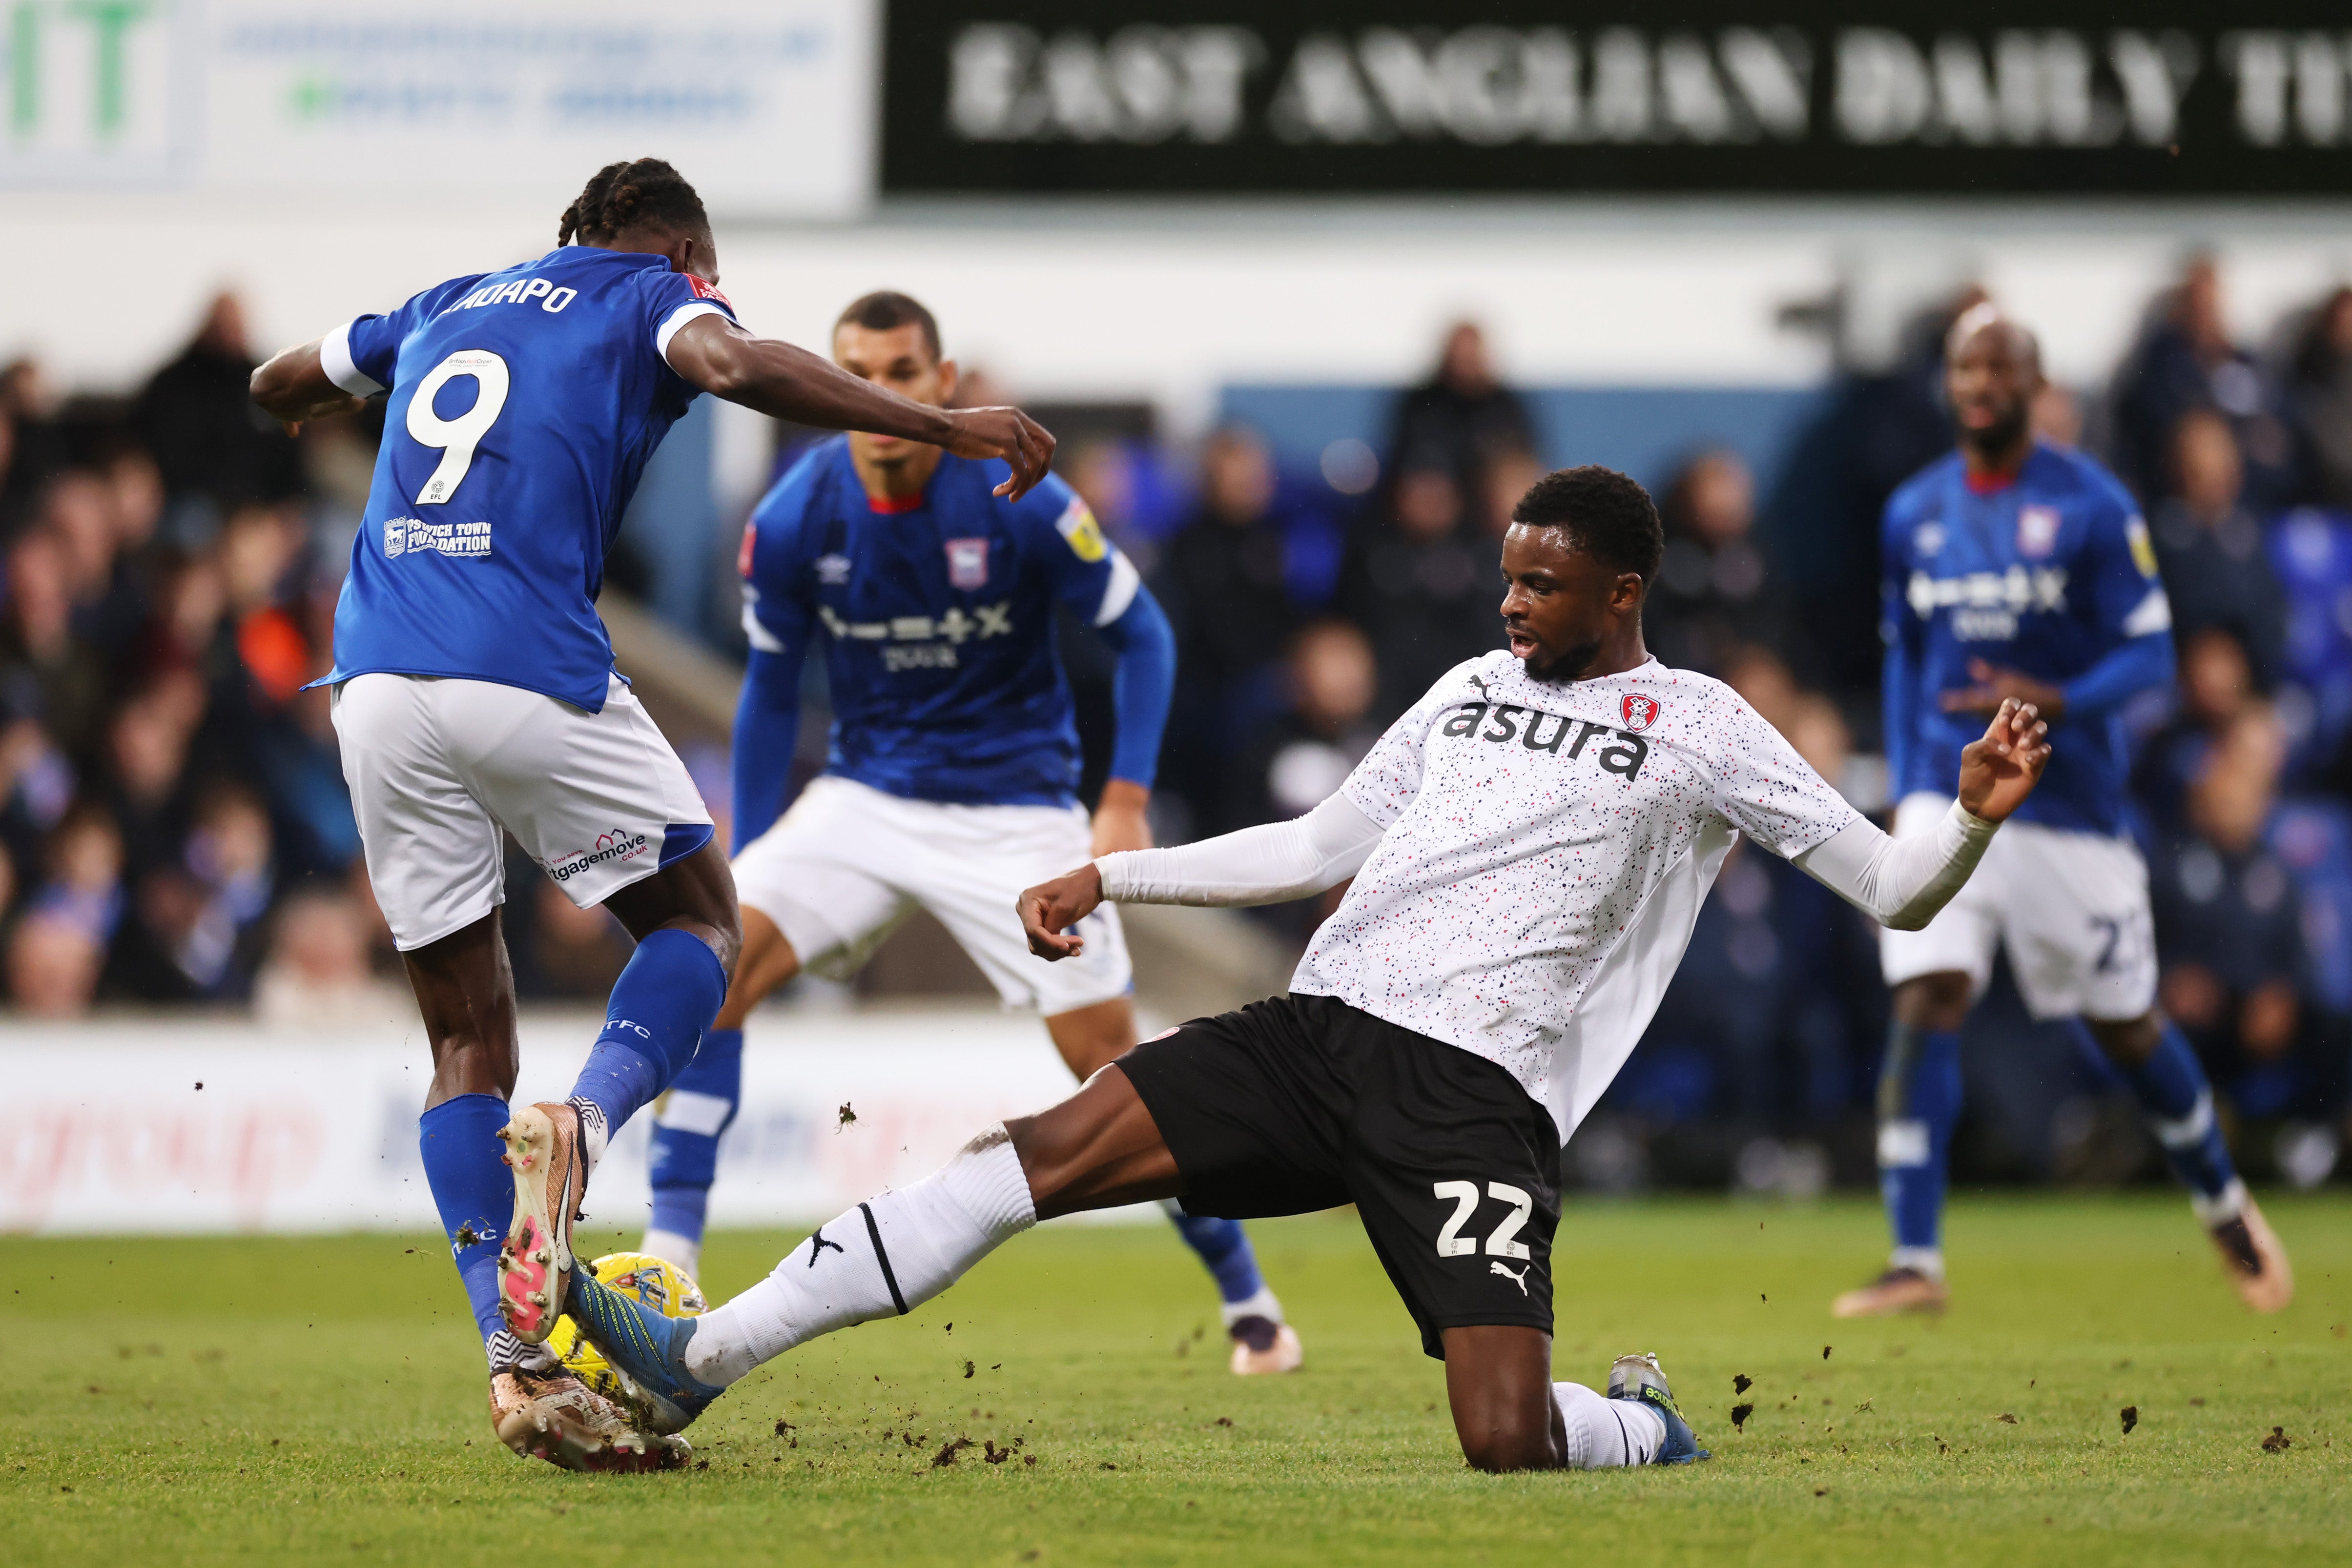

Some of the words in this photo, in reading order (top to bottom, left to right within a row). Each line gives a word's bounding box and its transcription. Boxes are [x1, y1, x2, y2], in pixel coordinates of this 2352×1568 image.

[949, 25, 1260, 146] EAST
[1268, 25, 1812, 149] ANGLIAN
[1831, 25, 2199, 150] DAILY
[406, 349, 510, 505] 9
[407, 519, 453, 537] IPSWICH
[456, 522, 492, 535] TOWN
[408, 530, 491, 551] FOUNDATION
[1442, 702, 1649, 782] asura
[552, 856, 566, 864] You
[567, 850, 585, 858] save.
[620, 845, 648, 862] .co.uk
[1434, 1181, 1532, 1260] 22
